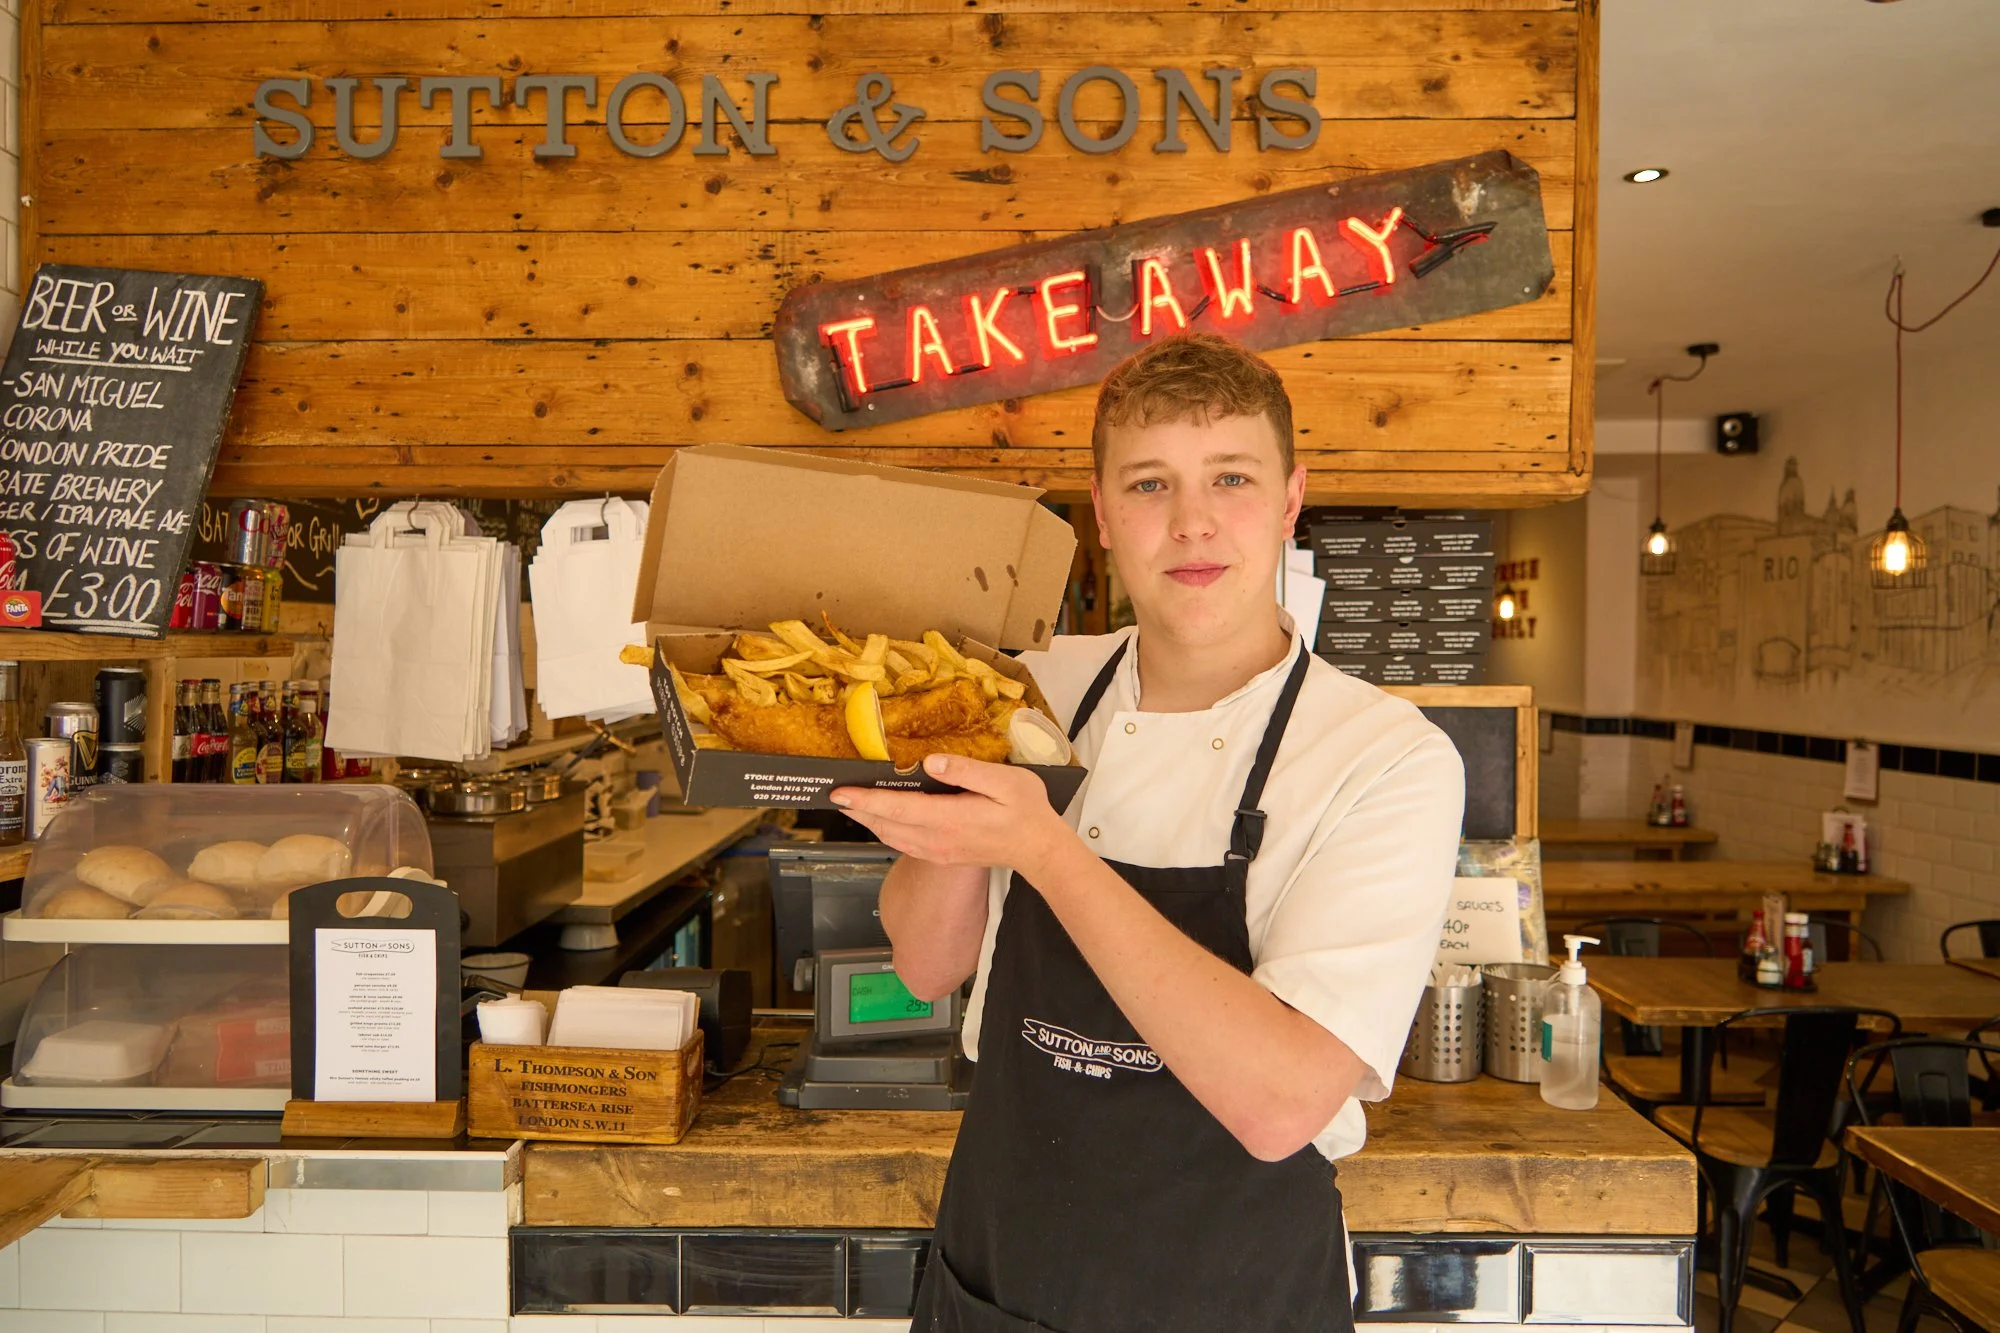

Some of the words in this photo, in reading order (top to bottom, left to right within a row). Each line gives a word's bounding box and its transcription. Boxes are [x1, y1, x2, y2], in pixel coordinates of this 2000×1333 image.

[253, 73, 778, 159] SUTTON
[828, 72, 925, 161] &
[981, 66, 1321, 154] SONS
[22, 276, 115, 333] BEER
[112, 304, 137, 318] OR
[143, 286, 246, 345] WINE
[827, 271, 1097, 393] TAKE
[1140, 207, 1405, 335] AWAY
[36, 338, 101, 359] WHILE
[149, 345, 204, 364] WAIT
[67, 375, 164, 409] MIGUEL
[3, 403, 93, 433] CORONA
[0, 435, 89, 467] ONDON
[91, 440, 173, 469] PRIDE
[50, 473, 164, 506] BREWERY
[158, 509, 191, 534] ALE
[287, 523, 305, 549] OR
[46, 532, 82, 561] OF
[79, 535, 159, 568] WINE
[1764, 555, 1799, 582] RIO
[5, 602, 29, 613] FANTA
[42, 569, 162, 623] £3.00
[751, 784, 782, 792] London
[776, 775, 834, 785] NEWINGTON
[770, 793, 790, 801] 7249
[1038, 1028, 1093, 1057] SUTTON
[1094, 1045, 1112, 1056] AND
[1113, 1047, 1158, 1066] SONS
[494, 1058, 512, 1073] L.
[608, 1069, 620, 1079] &
[1054, 1056, 1072, 1071] FISH
[1085, 1064, 1112, 1079] CHIPS
[521, 1081, 627, 1098] FISHMONGERS
[513, 1098, 597, 1113] BATTERSEA
[601, 1103, 634, 1115] RISE
[519, 1115, 580, 1129] LONDON
